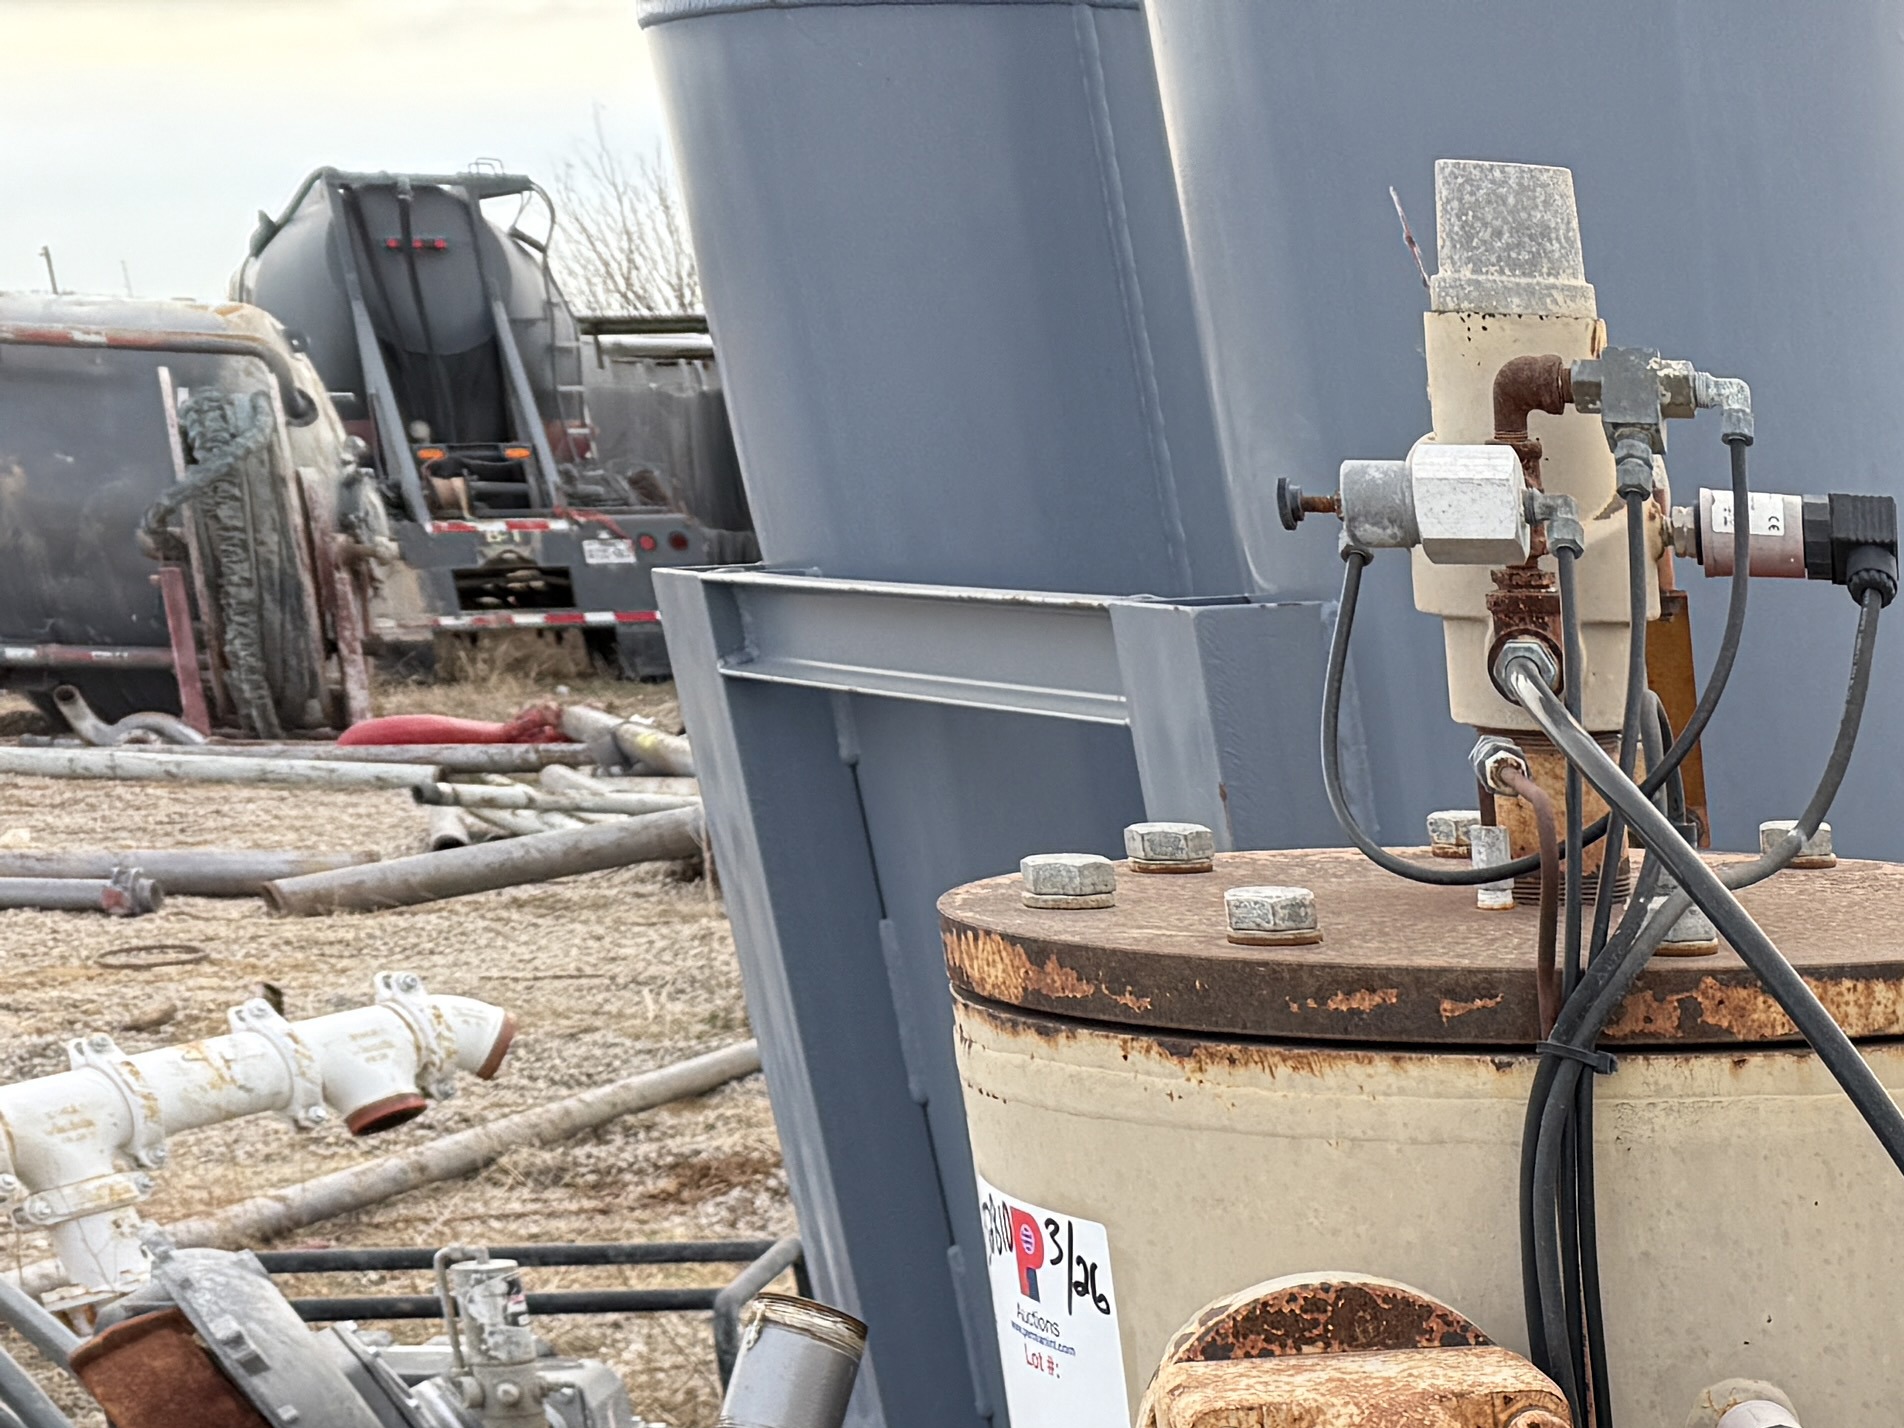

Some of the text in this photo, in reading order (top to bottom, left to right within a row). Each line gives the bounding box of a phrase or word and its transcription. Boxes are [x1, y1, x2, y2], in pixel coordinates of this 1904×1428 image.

[1044, 1217, 1111, 1316] 3/26
[1017, 1303, 1060, 1337] Auctions
[1024, 1343, 1044, 1372] Lot
